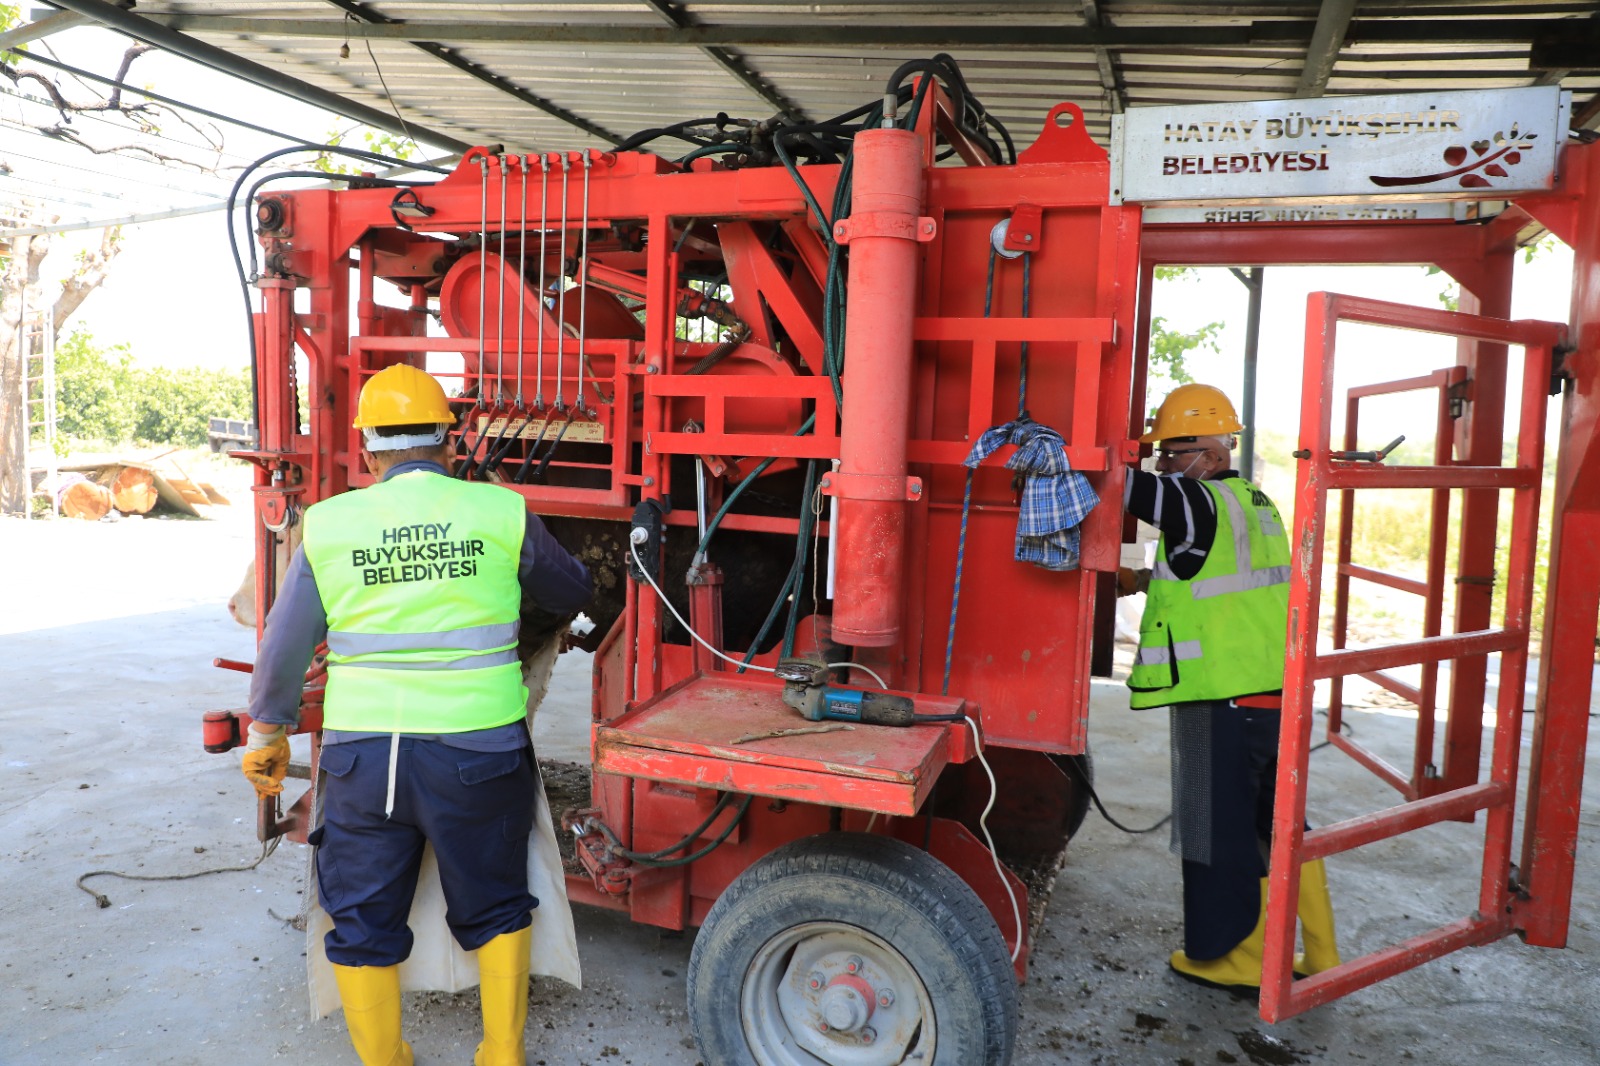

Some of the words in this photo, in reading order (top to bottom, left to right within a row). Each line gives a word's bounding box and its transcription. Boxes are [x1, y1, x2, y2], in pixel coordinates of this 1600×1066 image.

[1164, 119, 1258, 143] HATAY
[1265, 105, 1463, 141] BÜYÜKŞEHİR
[1163, 144, 1330, 175] BELEDİYESİ
[382, 522, 452, 544] HATAY
[363, 559, 477, 586] BELEDİYESİ
